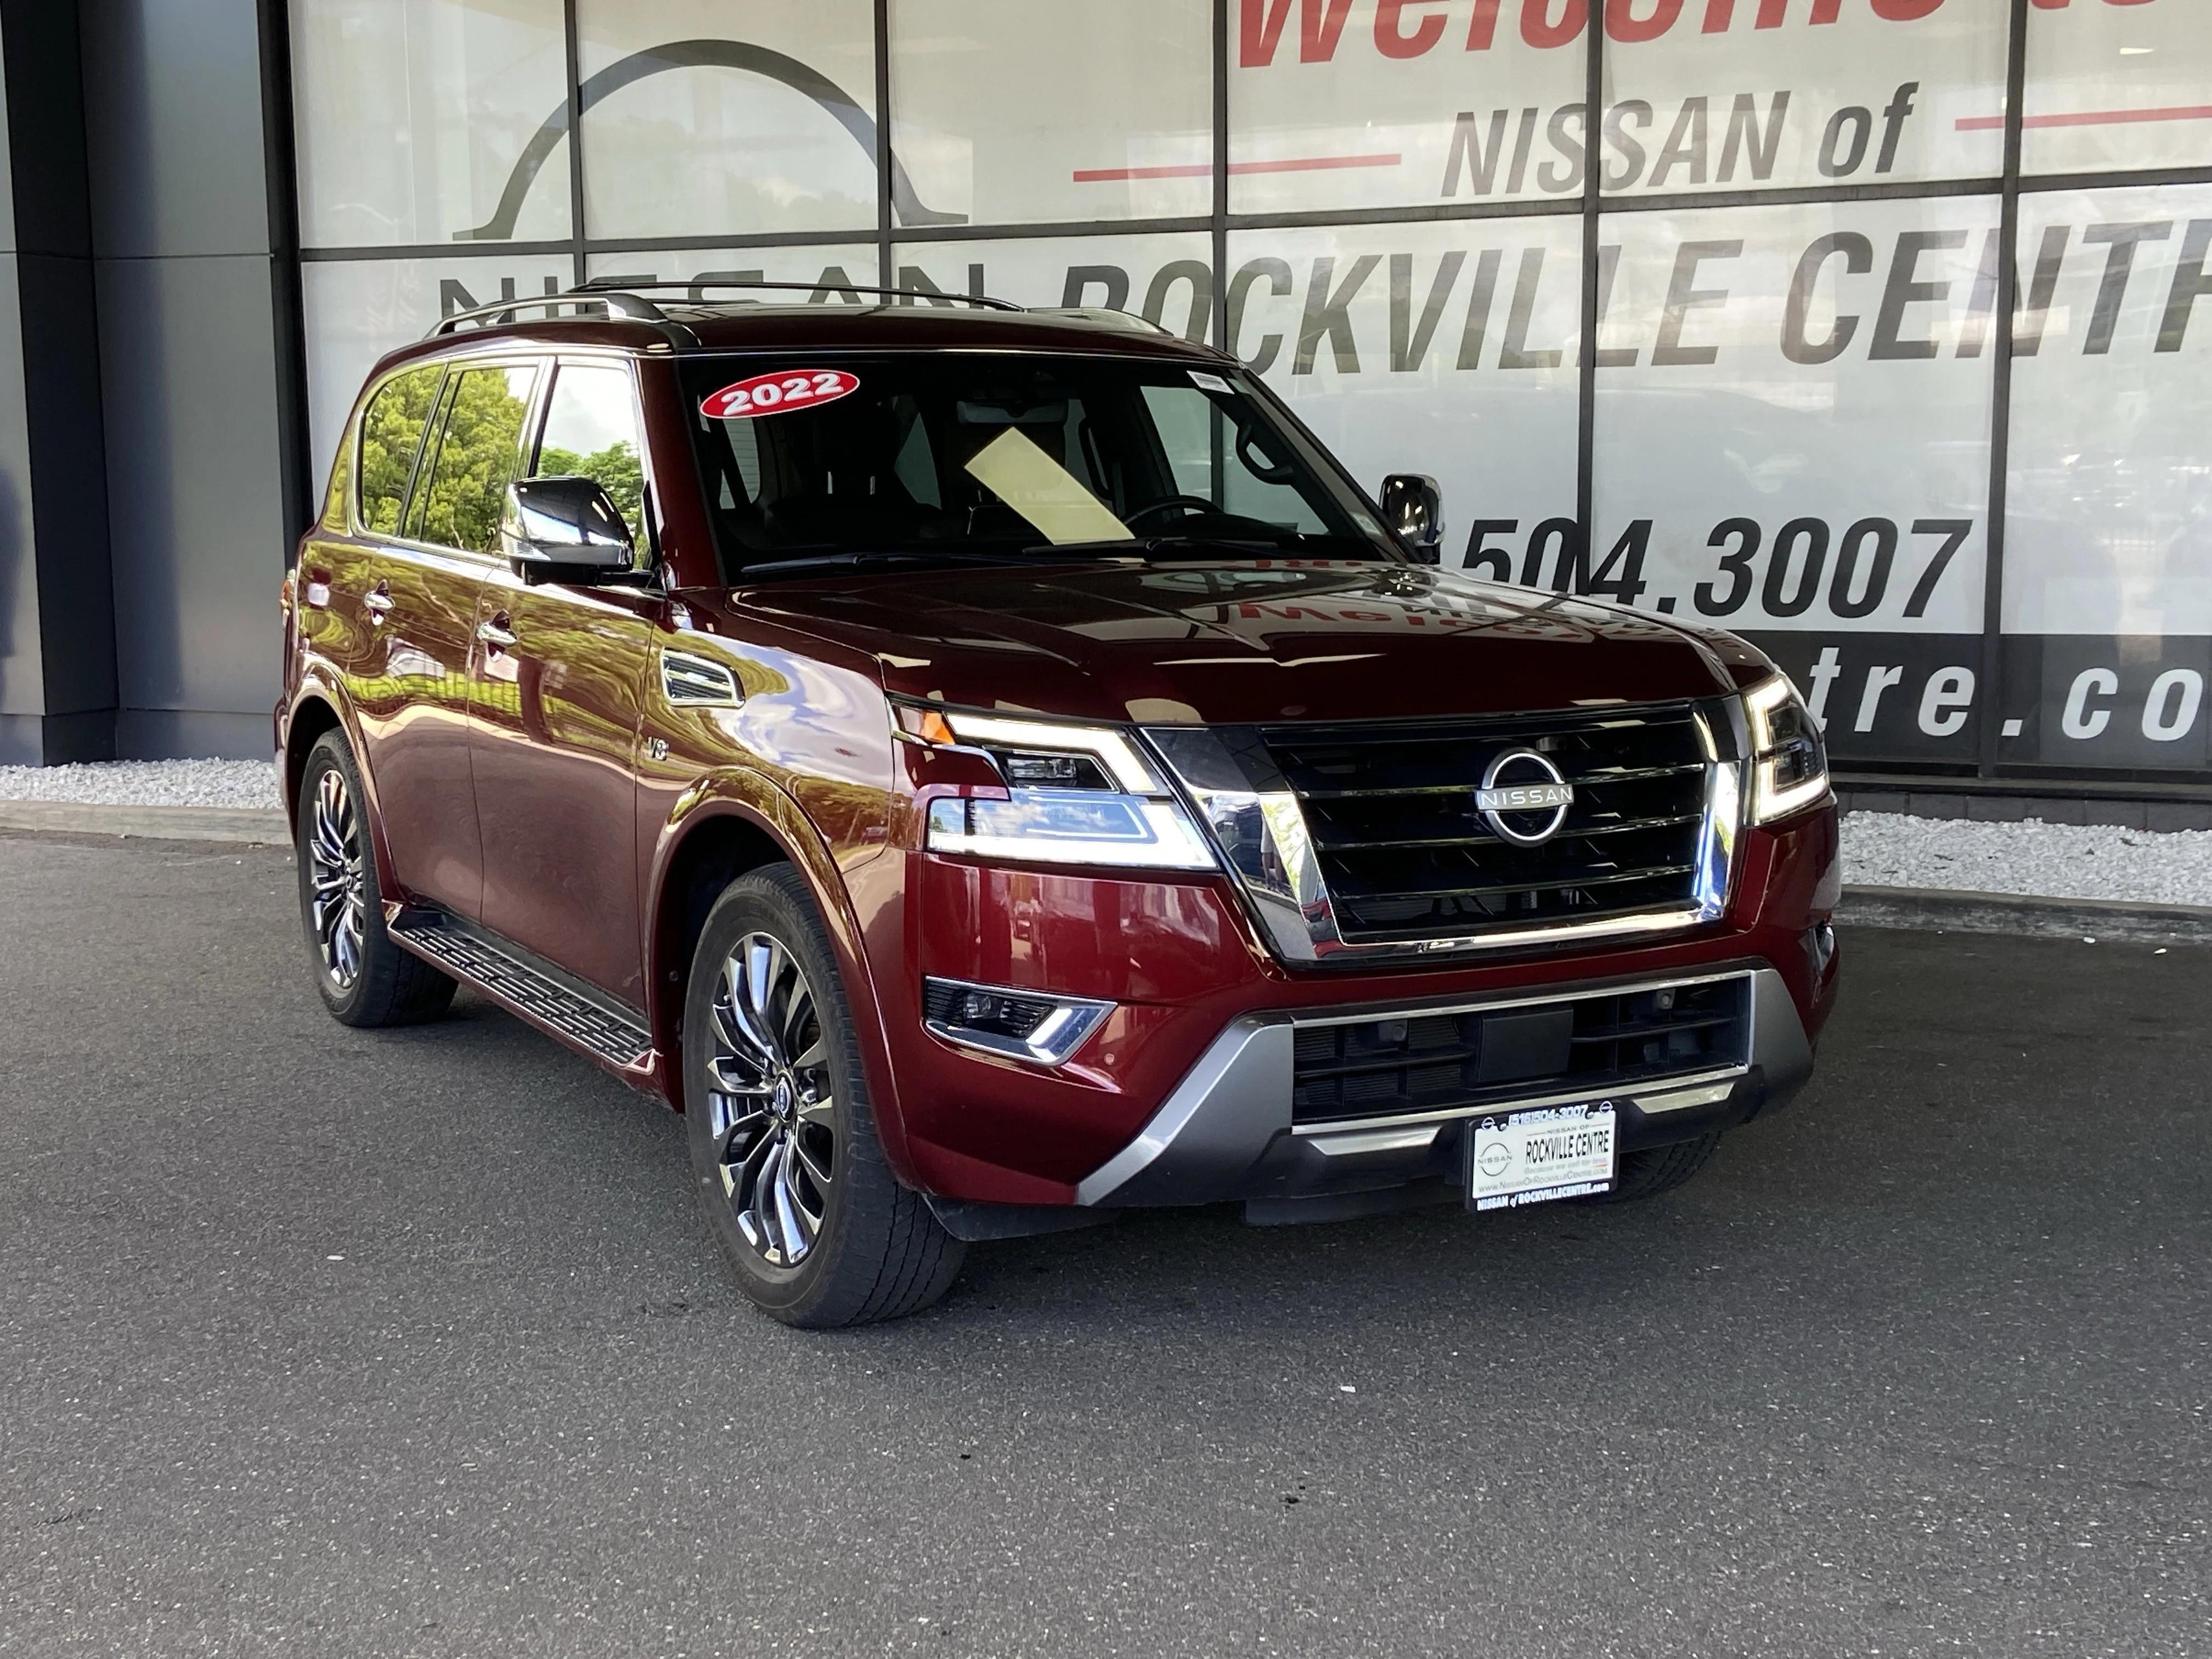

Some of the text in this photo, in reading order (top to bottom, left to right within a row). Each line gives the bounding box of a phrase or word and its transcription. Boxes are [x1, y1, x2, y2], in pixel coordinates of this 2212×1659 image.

[1441, 82, 1919, 198] NISSAN of
[721, 373, 844, 416] 2022
[1462, 517, 1973, 619] 504.3007
[1482, 788, 1572, 806] NISSAN
[1478, 1155, 1512, 1164] NISSAN
[1526, 1130, 1609, 1164] ROCKVILLE CENTRE
[1477, 1195, 1508, 1211] NISSAN
